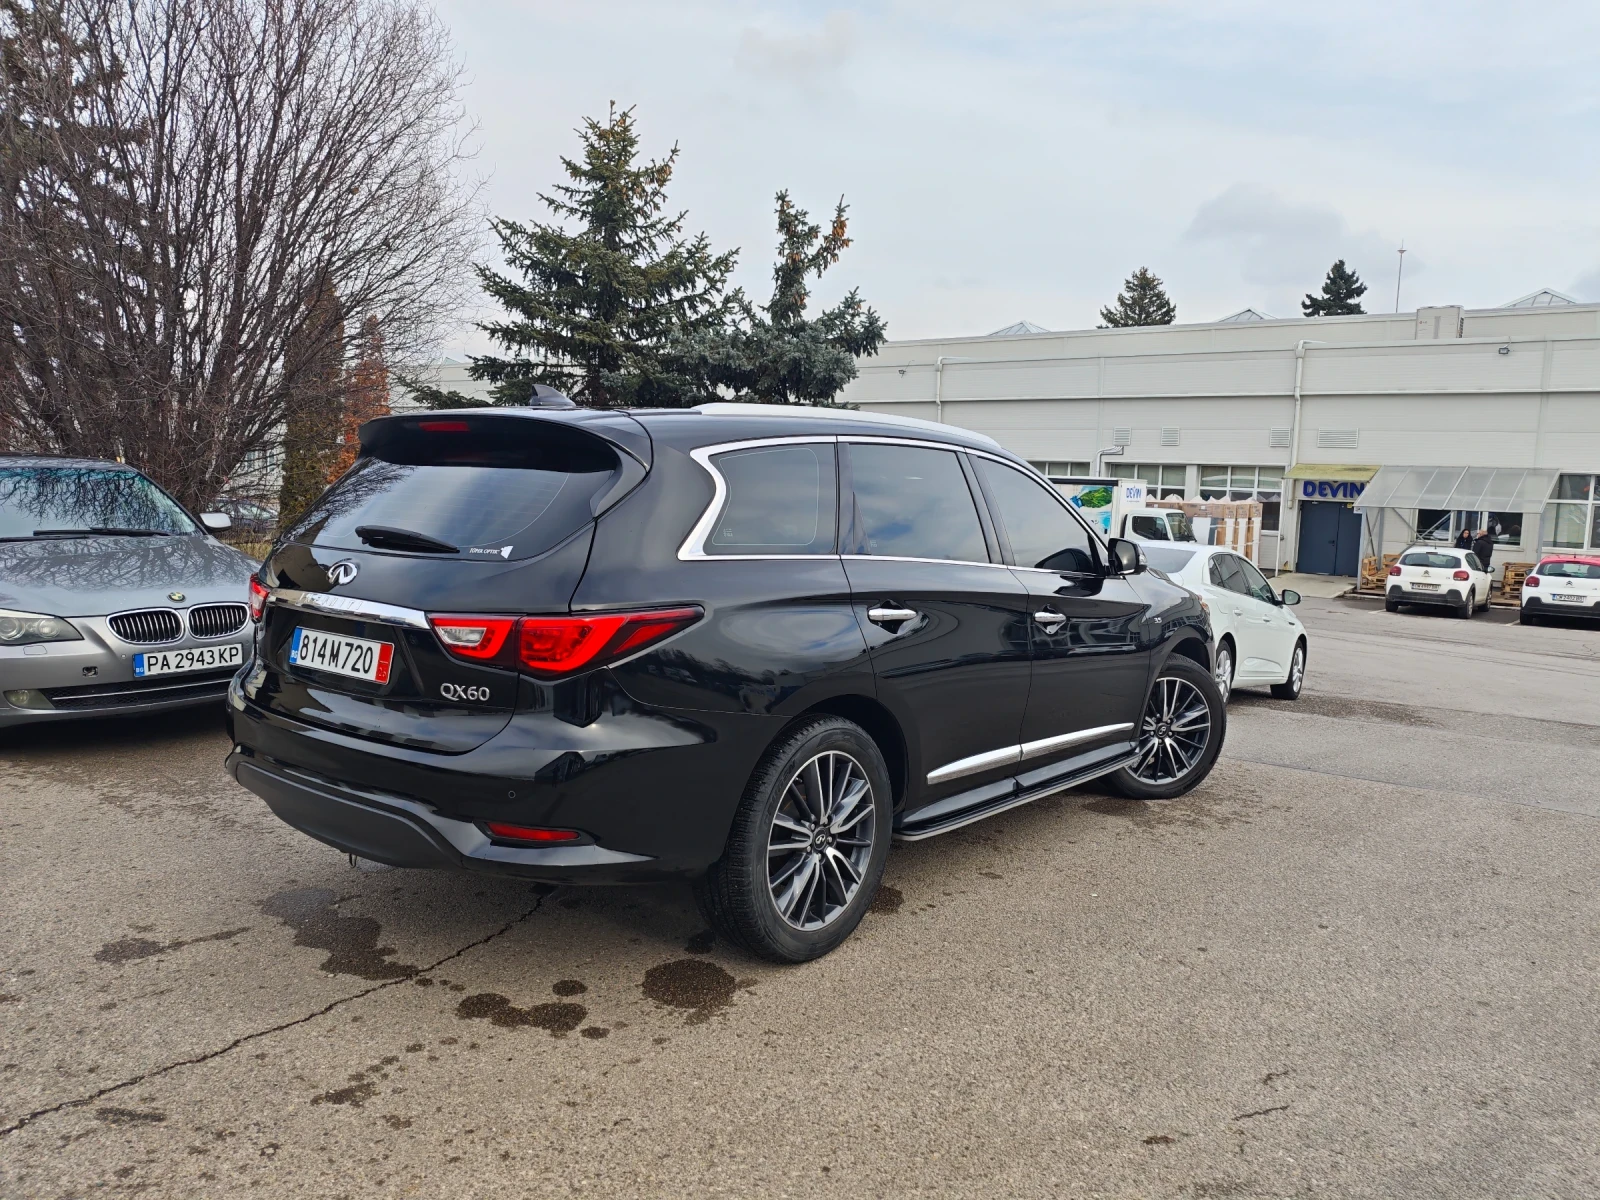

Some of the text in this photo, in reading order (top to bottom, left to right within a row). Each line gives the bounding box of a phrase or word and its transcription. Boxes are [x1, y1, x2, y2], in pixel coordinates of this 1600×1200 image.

[1126, 486, 1142, 499] DEVIN
[1303, 481, 1364, 498] DEVIN
[147, 646, 239, 672] PA 2943 KP
[440, 683, 490, 701] QX60
